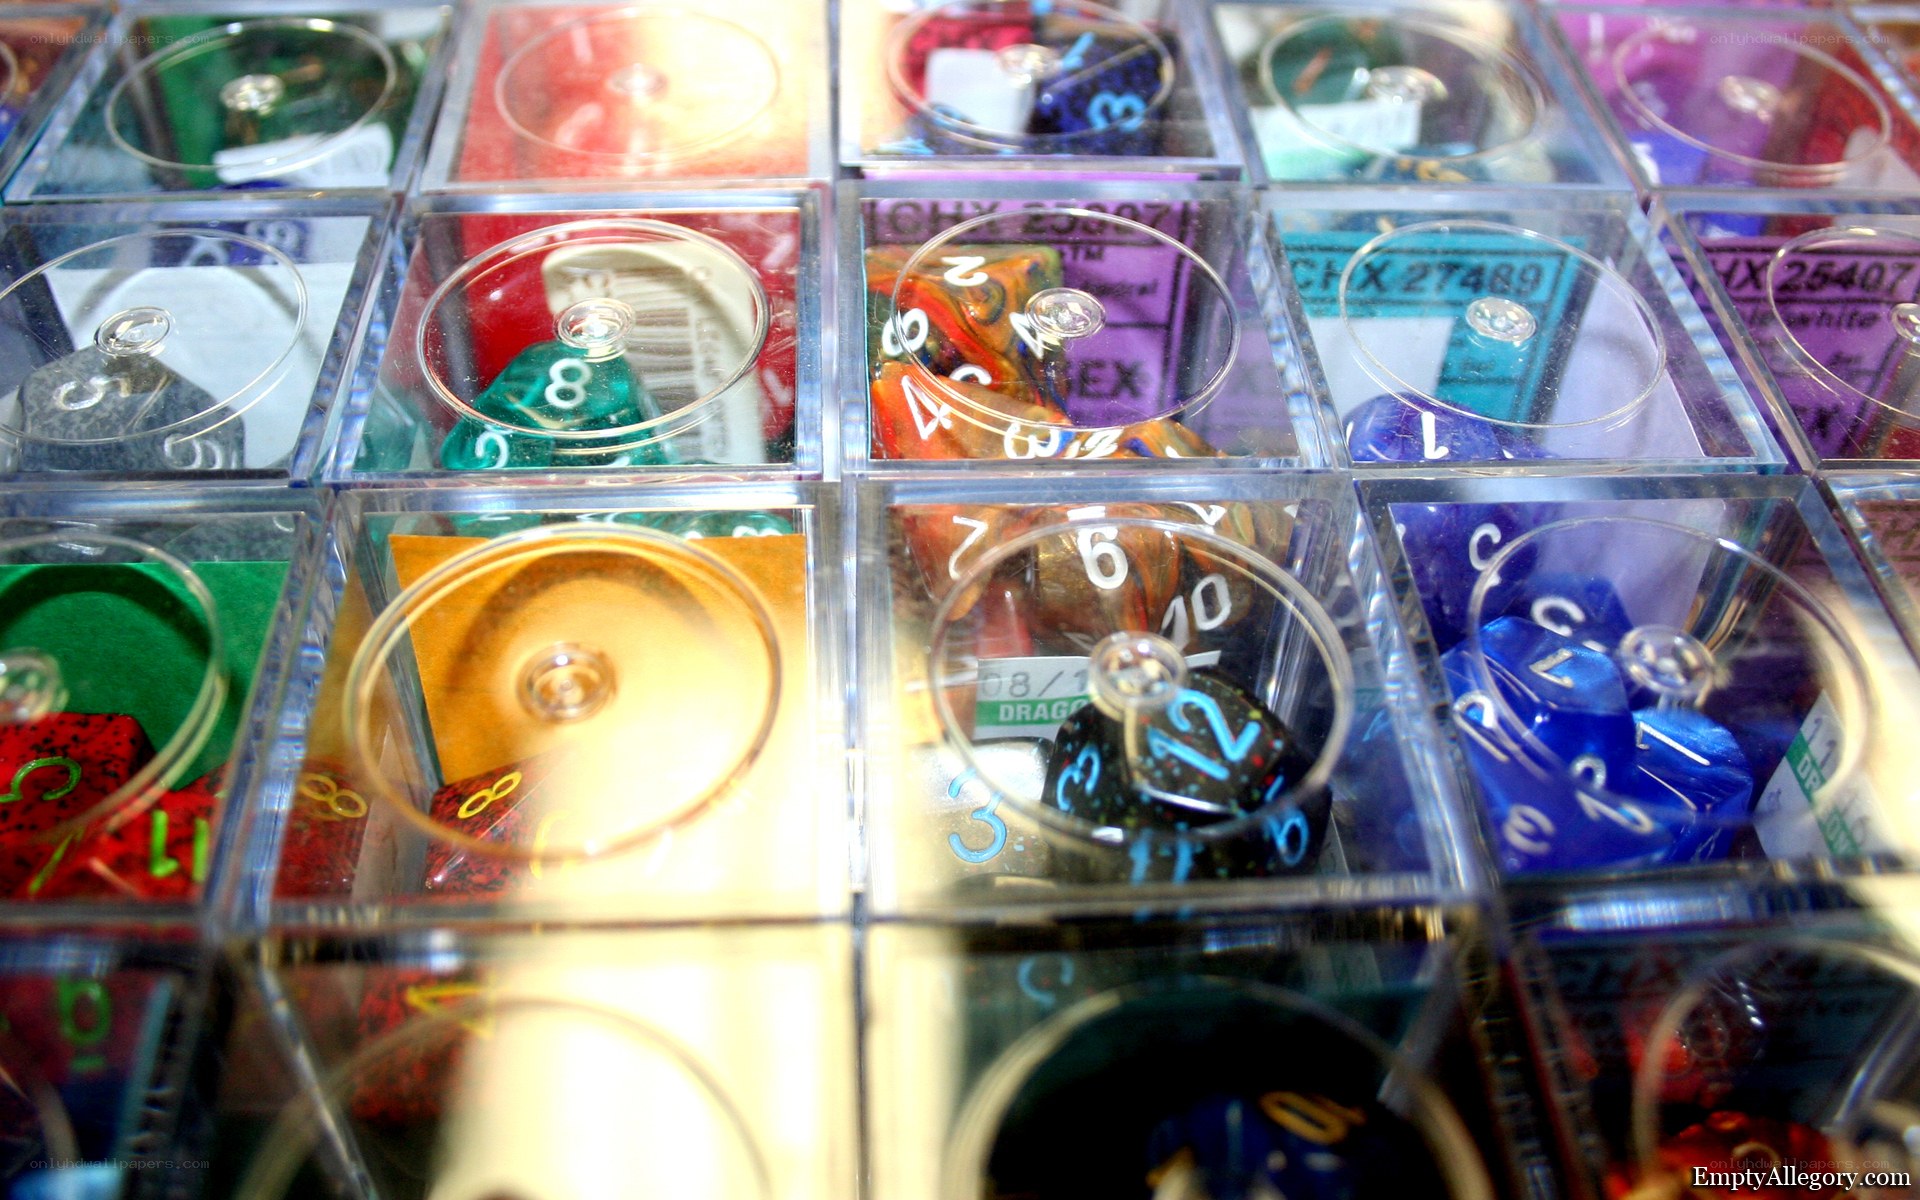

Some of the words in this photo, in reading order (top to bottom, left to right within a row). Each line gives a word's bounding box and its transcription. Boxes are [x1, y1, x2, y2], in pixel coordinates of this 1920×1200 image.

[887, 202, 1000, 235] CHX
[1291, 257, 1391, 293] CHX
[1777, 259, 1915, 294] 25407
[545, 358, 592, 409] 8
[901, 375, 953, 440] 4
[981, 669, 1090, 699] 08/1
[999, 697, 1090, 722] DRAG
[1147, 687, 1262, 782] 12
[457, 771, 522, 820] 8
[1057, 745, 1101, 812] 3
[947, 767, 1008, 864] 3
